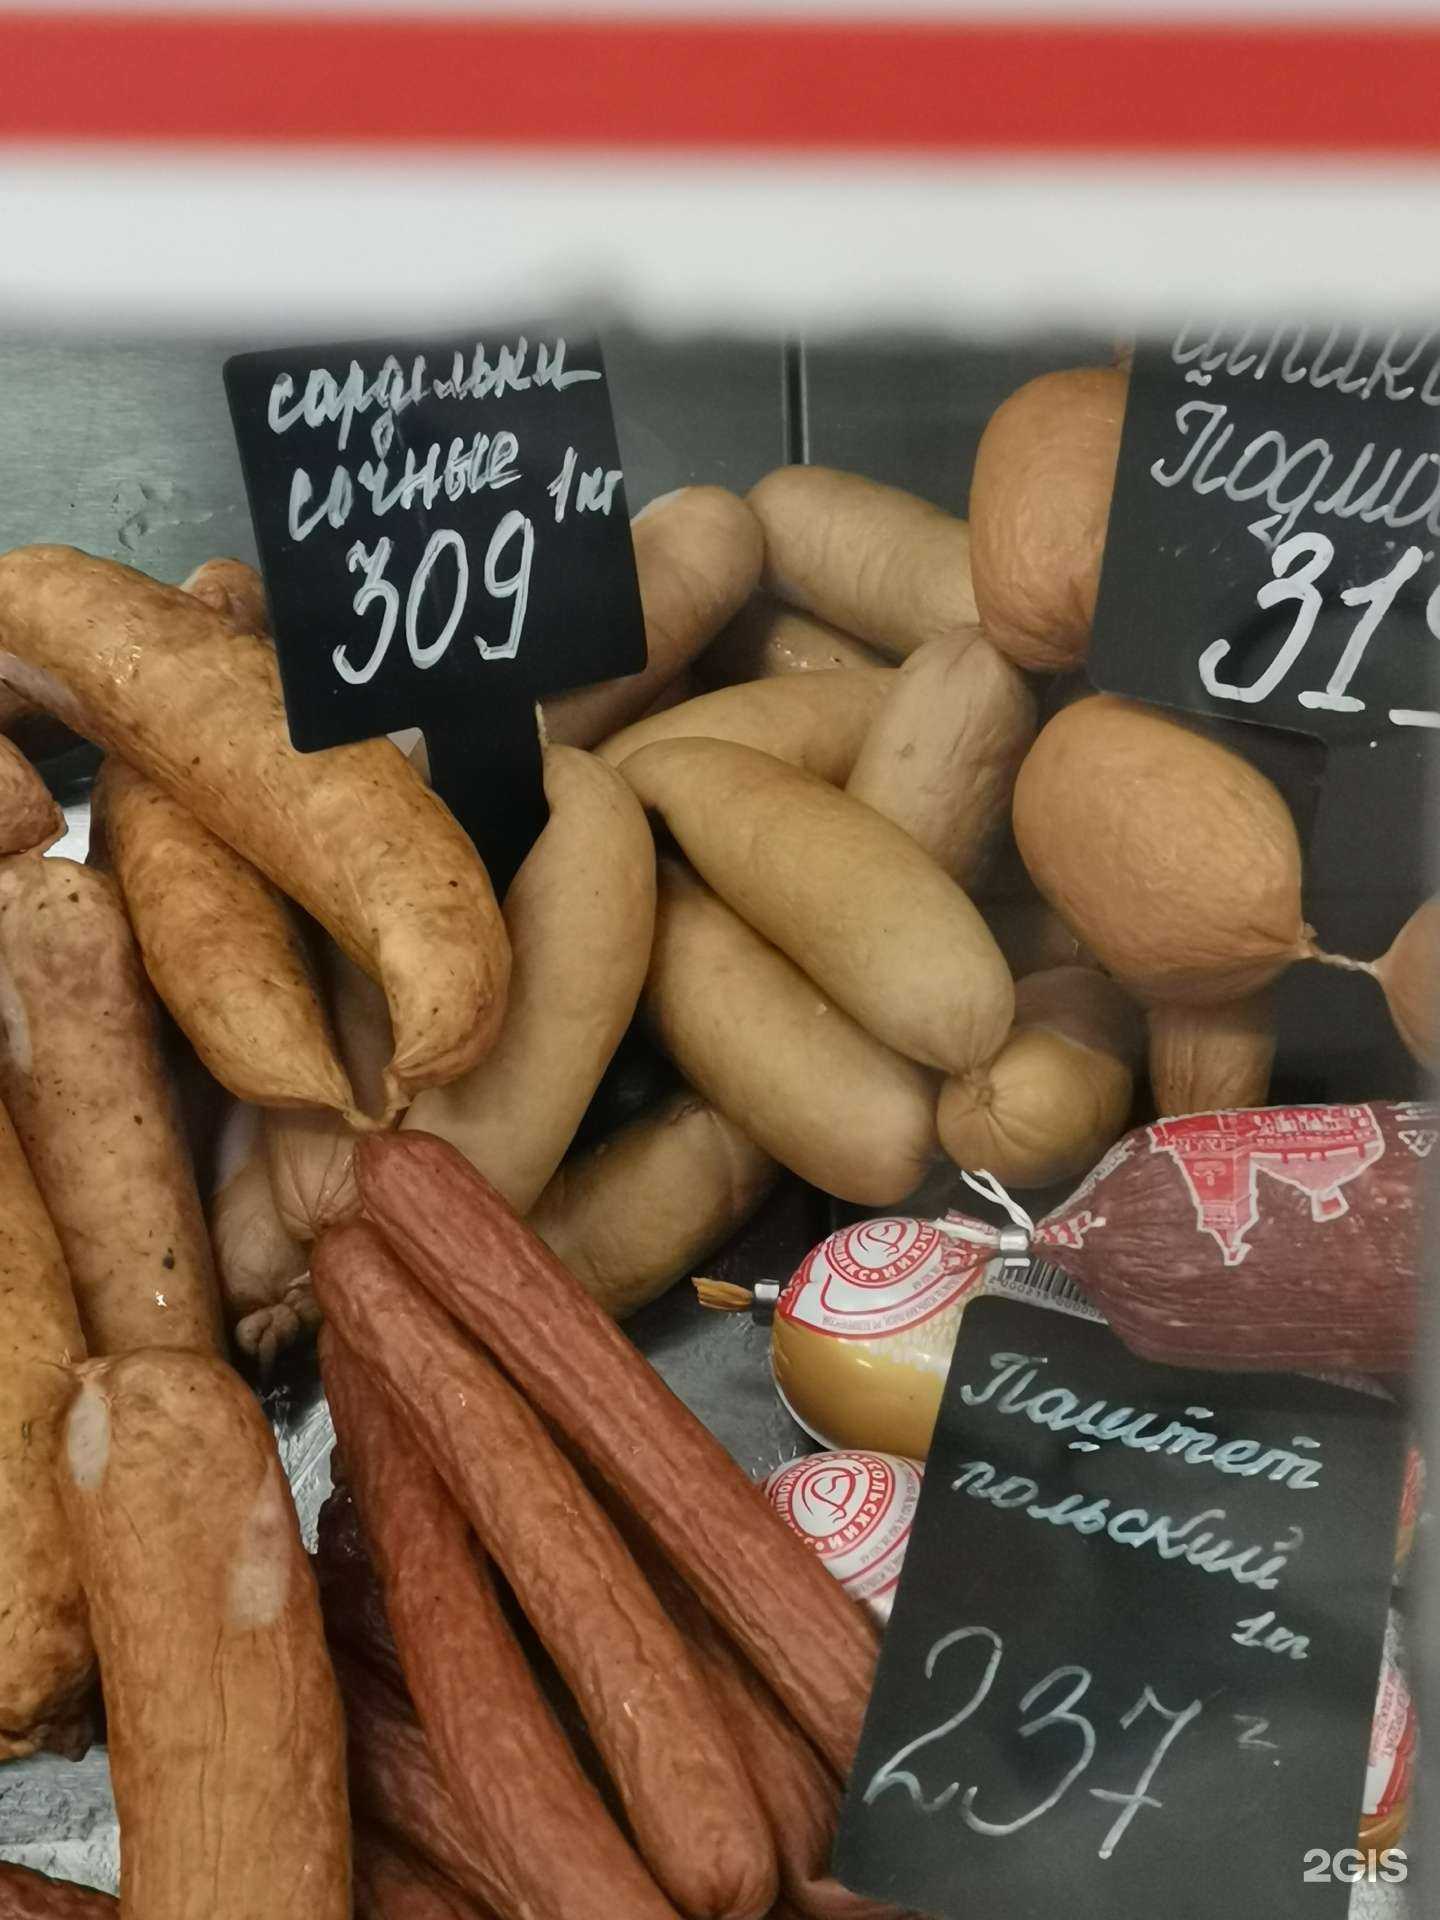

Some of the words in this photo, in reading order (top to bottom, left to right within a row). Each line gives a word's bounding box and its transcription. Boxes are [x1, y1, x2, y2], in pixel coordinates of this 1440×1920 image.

[288, 431, 522, 541] сочные
[546, 447, 623, 523] 1кг
[1150, 400, 1440, 552] Подмо
[332, 510, 534, 685] 309
[1199, 531, 1440, 727] 31
[961, 1352, 1321, 1489] Паштет
[952, 1461, 1304, 1590] польский
[862, 1626, 1202, 1860] 237
